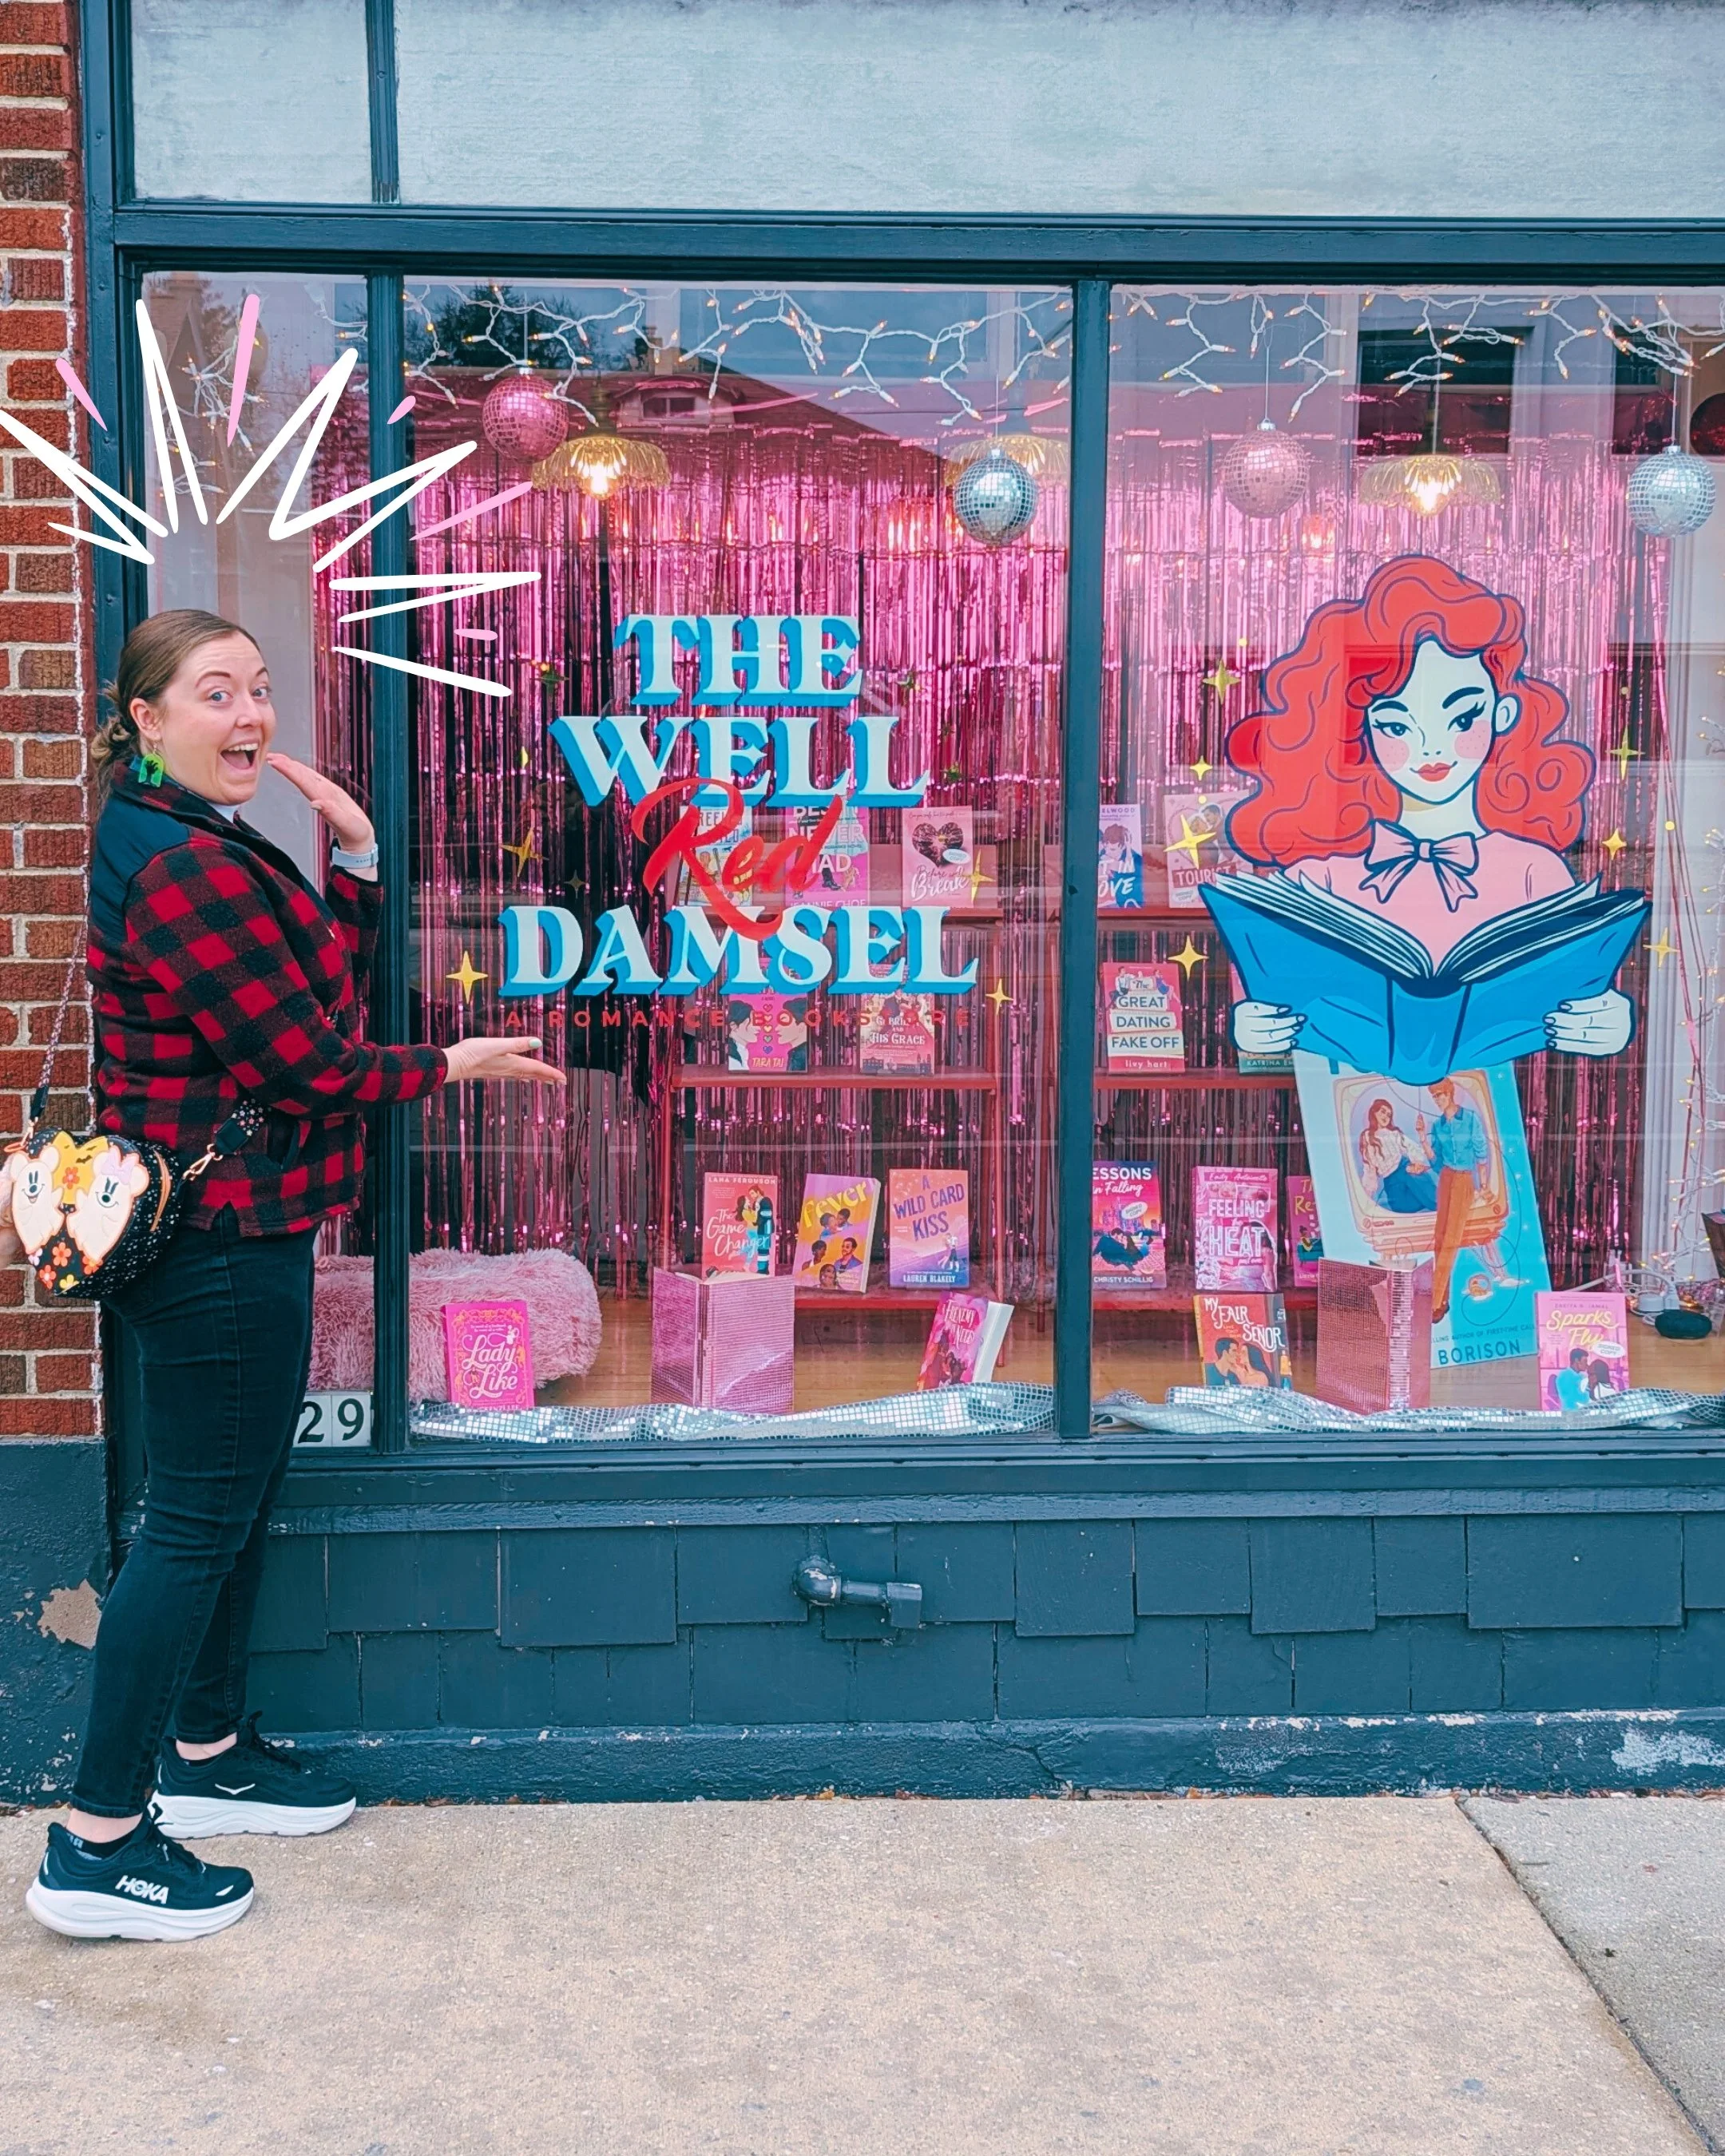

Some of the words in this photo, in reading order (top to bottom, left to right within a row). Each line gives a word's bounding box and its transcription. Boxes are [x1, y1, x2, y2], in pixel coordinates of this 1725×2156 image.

[613, 614, 863, 706] THE
[549, 715, 930, 807] WELL
[632, 778, 843, 941] Red
[911, 866, 969, 902] Break
[1099, 877, 1136, 898] OVE
[498, 906, 978, 996] DAMSEL
[1118, 997, 1165, 1008] GREAT
[505, 1011, 524, 1028] A
[549, 1010, 725, 1028] ROMANCE
[1116, 1016, 1171, 1028] DATING
[891, 1032, 926, 1045] GRACE
[1112, 1036, 1148, 1048] FAKE
[1150, 1036, 1180, 1048] OFF
[1125, 1059, 1144, 1071] livy
[1147, 1060, 1167, 1068] hart
[922, 1175, 931, 1190] A
[1092, 1167, 1152, 1180] ESSONS
[894, 1195, 926, 1219] WILD
[930, 1183, 965, 1209] CARD
[1105, 1181, 1144, 1198] Falling
[716, 1208, 735, 1223] The
[1208, 1198, 1266, 1218] FEELING
[707, 1216, 746, 1239] Game
[912, 1211, 950, 1242] KISS
[714, 1234, 770, 1261] Changer
[1208, 1225, 1265, 1258] HEAT
[902, 1274, 928, 1283] LAUREN
[1204, 1297, 1219, 1321] MY
[1214, 1305, 1254, 1330] FAIR
[1546, 1310, 1620, 1331] Sparks
[1242, 1323, 1286, 1353] SEÑOR
[1568, 1326, 1604, 1352] Fly
[462, 1334, 518, 1370] Lady
[1438, 1339, 1521, 1365] BORISON
[463, 1361, 518, 1399] Like
[298, 1398, 365, 1444] 29
[115, 1875, 169, 1904] HOKA
